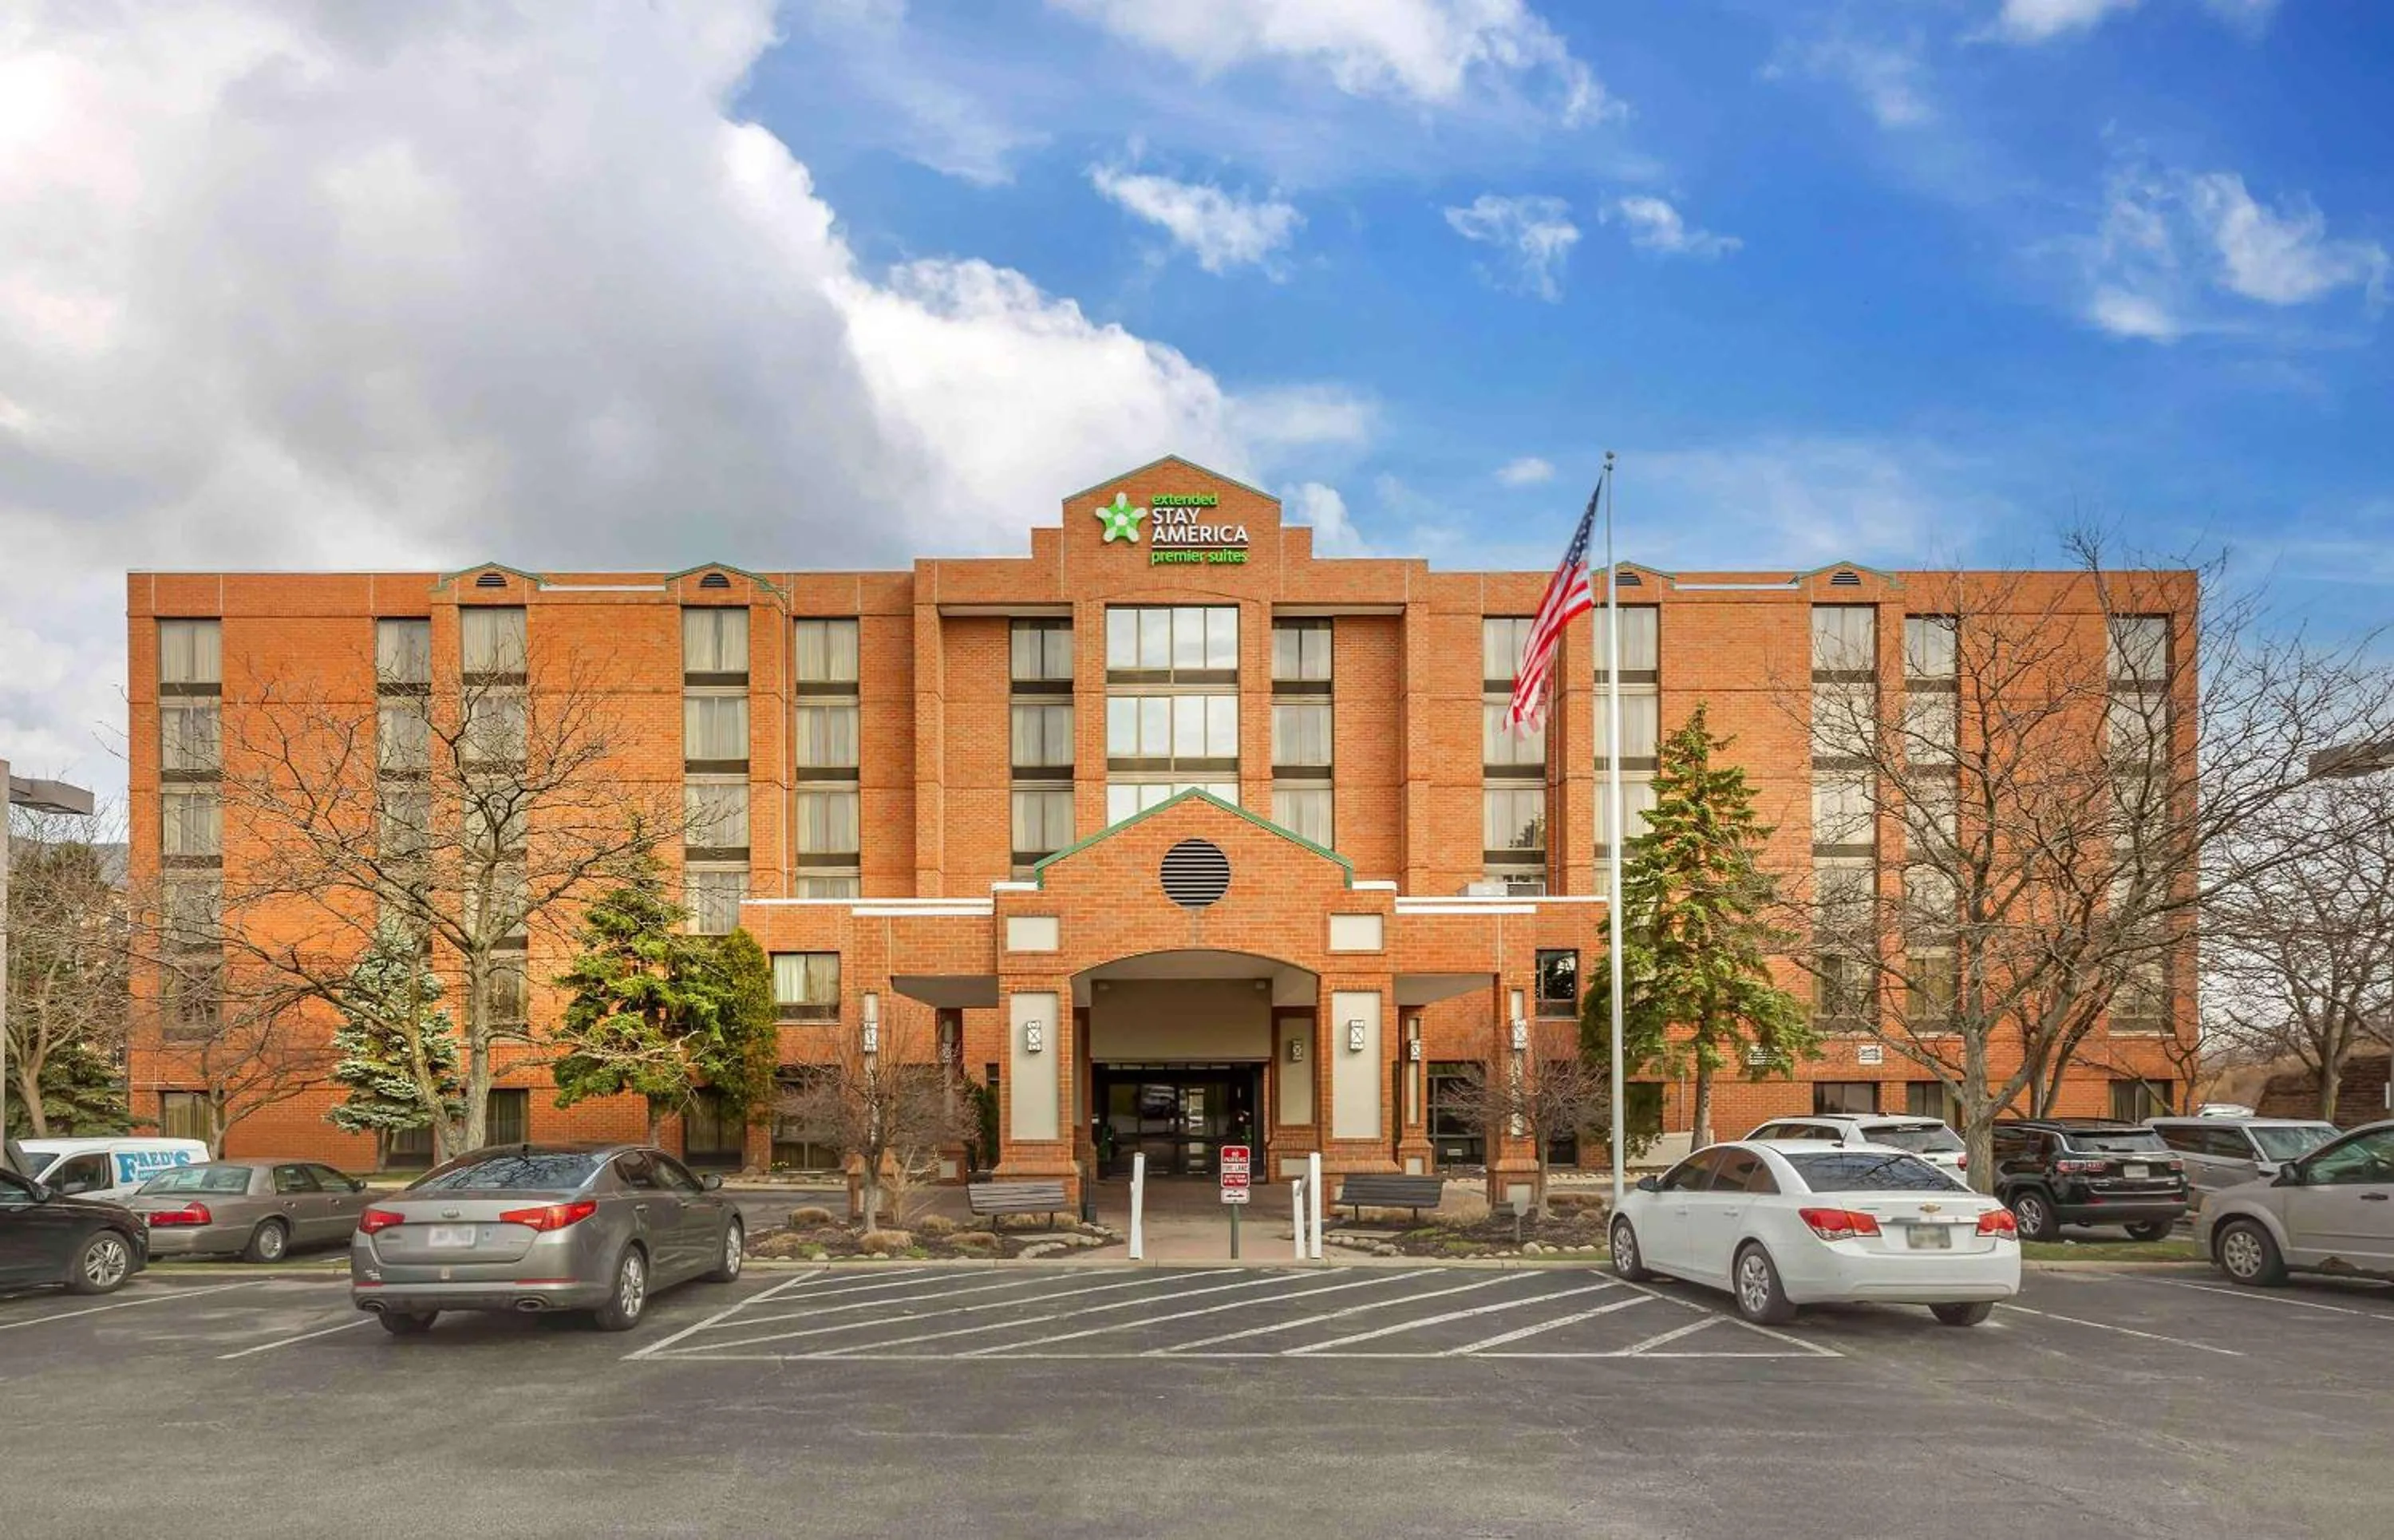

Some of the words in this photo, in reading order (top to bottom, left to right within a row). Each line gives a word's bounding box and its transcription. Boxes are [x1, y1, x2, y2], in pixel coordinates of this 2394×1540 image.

[1152, 493, 1218, 506] extended
[1152, 507, 1200, 524] STAY
[1152, 525, 1249, 543] AMERICA
[1152, 549, 1203, 566] premier
[1208, 548, 1249, 563] suites
